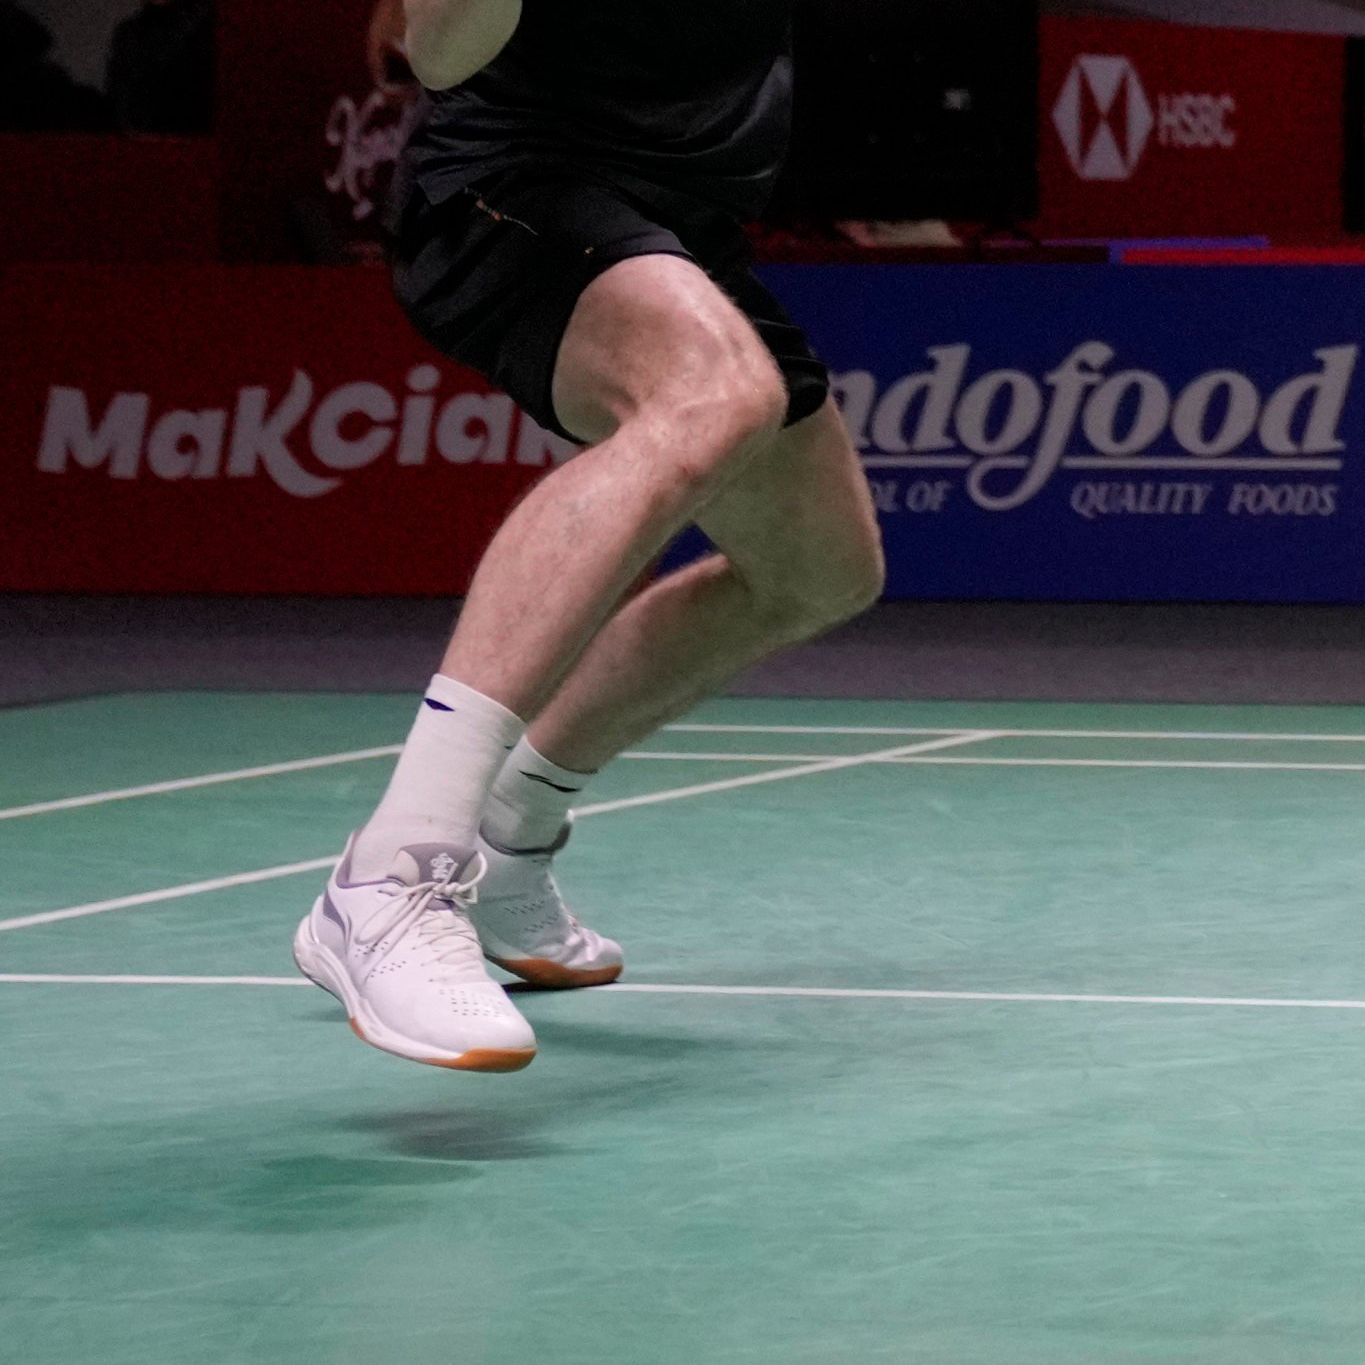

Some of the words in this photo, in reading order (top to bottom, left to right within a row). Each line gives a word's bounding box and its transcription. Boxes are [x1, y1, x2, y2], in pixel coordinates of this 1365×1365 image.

[1157, 91, 1236, 147] HSBC
[828, 340, 1360, 511] ndofood
[905, 480, 952, 512] OF
[1070, 481, 1215, 517] QUALITY
[1228, 483, 1338, 516] FOODS
